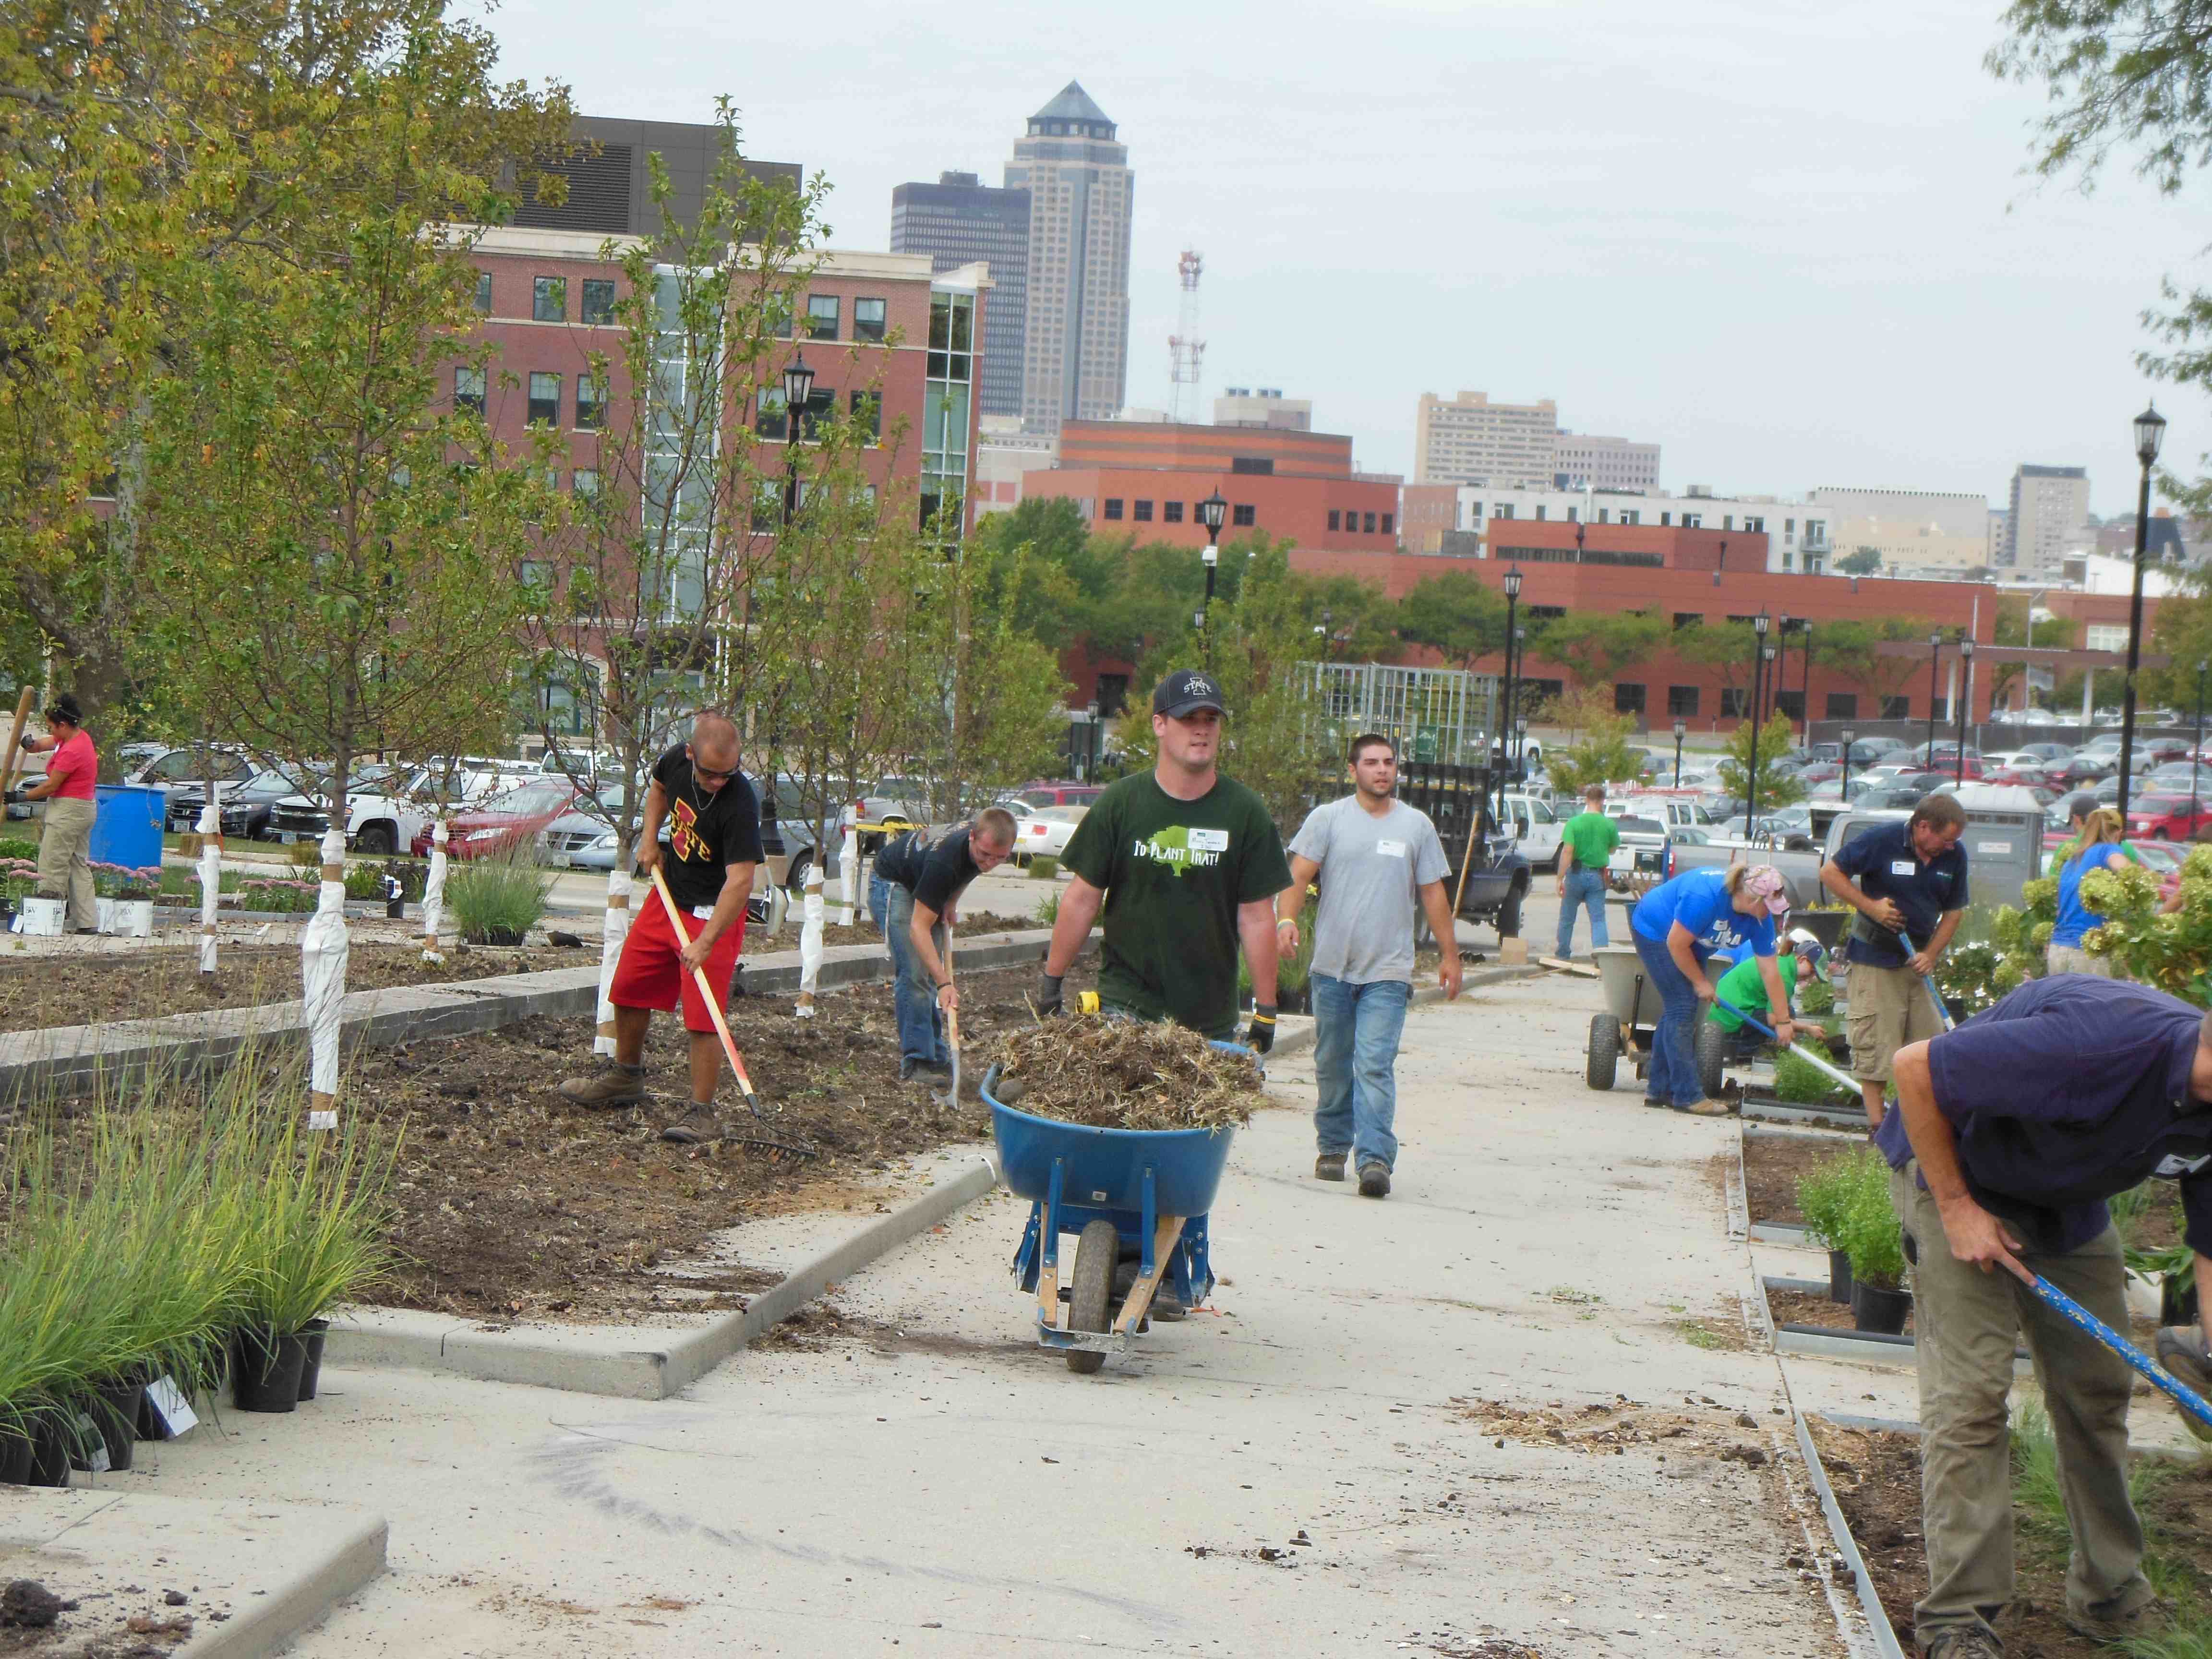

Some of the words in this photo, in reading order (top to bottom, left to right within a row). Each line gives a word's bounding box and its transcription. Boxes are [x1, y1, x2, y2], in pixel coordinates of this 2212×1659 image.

[1184, 682, 1212, 693] STATE
[1133, 840, 1146, 856] I'D
[1150, 842, 1186, 861] PLANT
